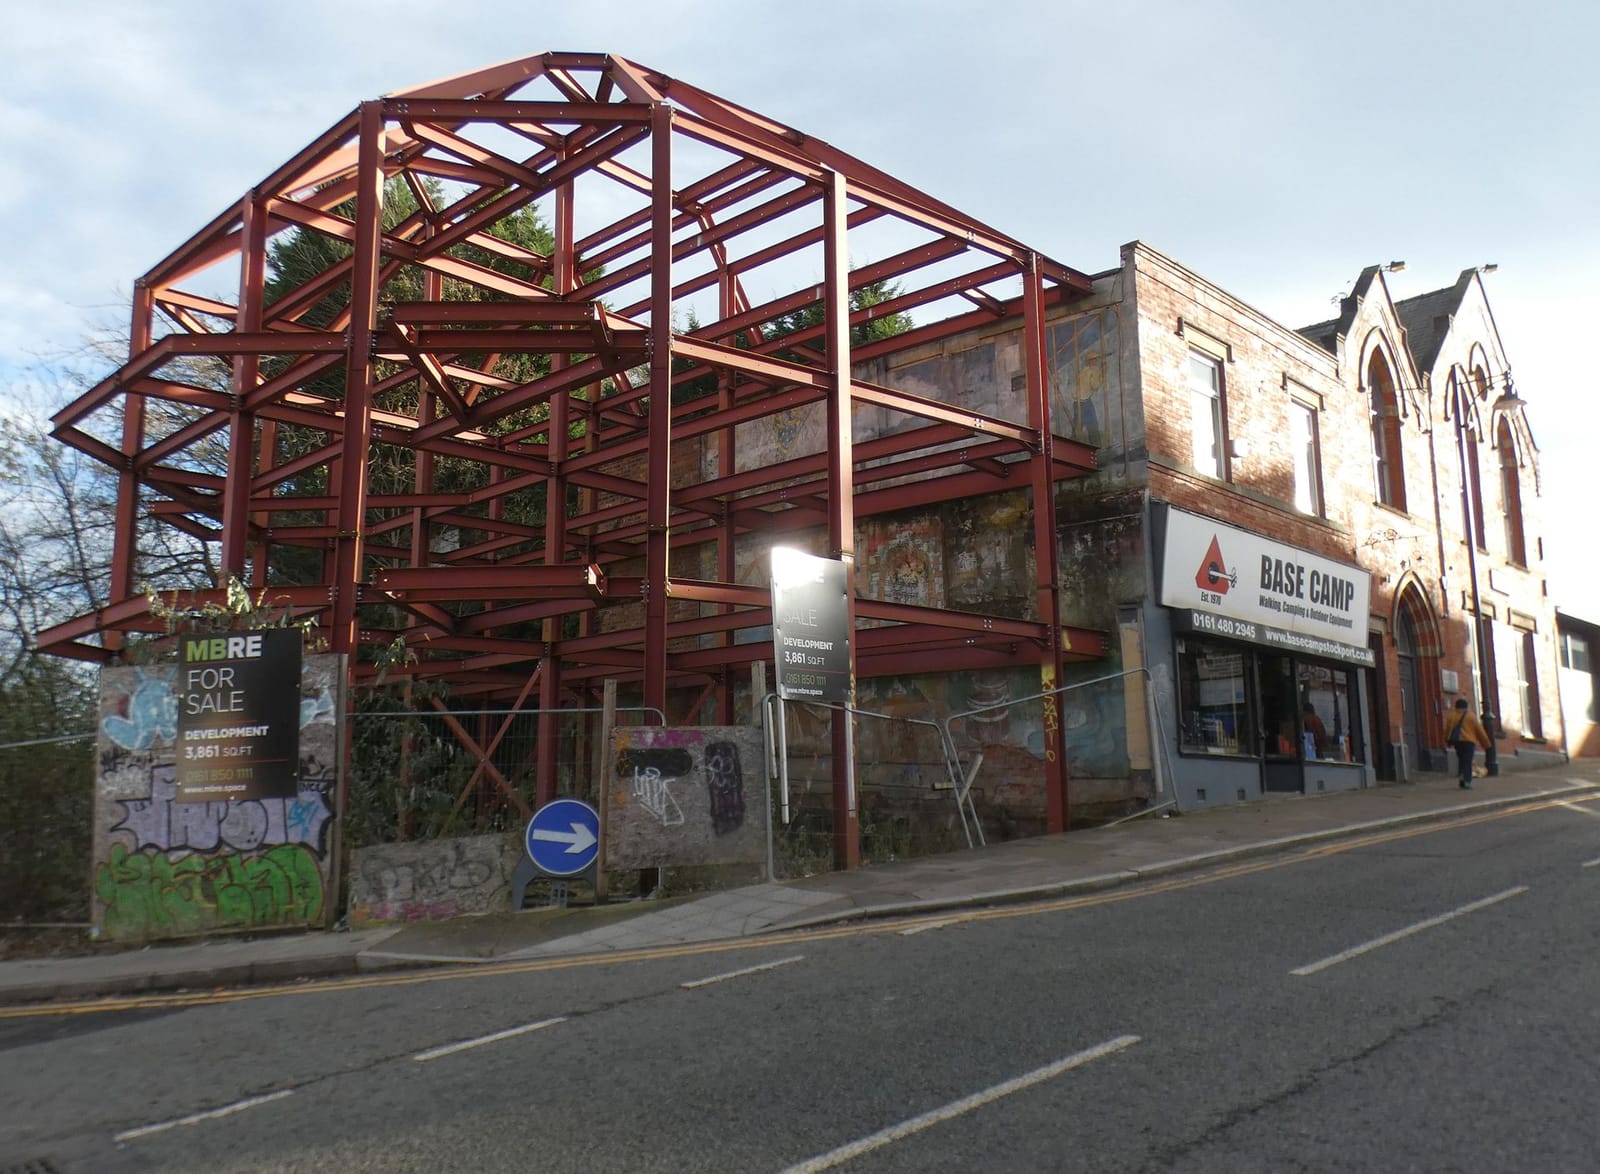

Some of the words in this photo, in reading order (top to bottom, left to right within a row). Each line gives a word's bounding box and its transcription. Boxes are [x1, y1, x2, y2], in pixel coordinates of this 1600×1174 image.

[1260, 555, 1304, 599] BASE
[1310, 570, 1354, 612] CAMP
[1201, 591, 1209, 602] Est.
[783, 608, 817, 627] SALE
[1193, 613, 1215, 630] 0161
[1217, 618, 1233, 633] 480
[1234, 622, 1256, 638] 2945
[1282, 601, 1305, 618] Camping
[1328, 613, 1353, 629] Equipment
[186, 635, 262, 661] MBRE
[783, 637, 833, 650] DEVELOPMENT
[1264, 629, 1374, 661] www.basecampstockport.co.uk
[784, 651, 806, 664] 3,861
[187, 667, 235, 690] FOR
[186, 690, 245, 715] SALE
[184, 726, 269, 740] DEVELOPMENT
[184, 745, 220, 760] 3,861
